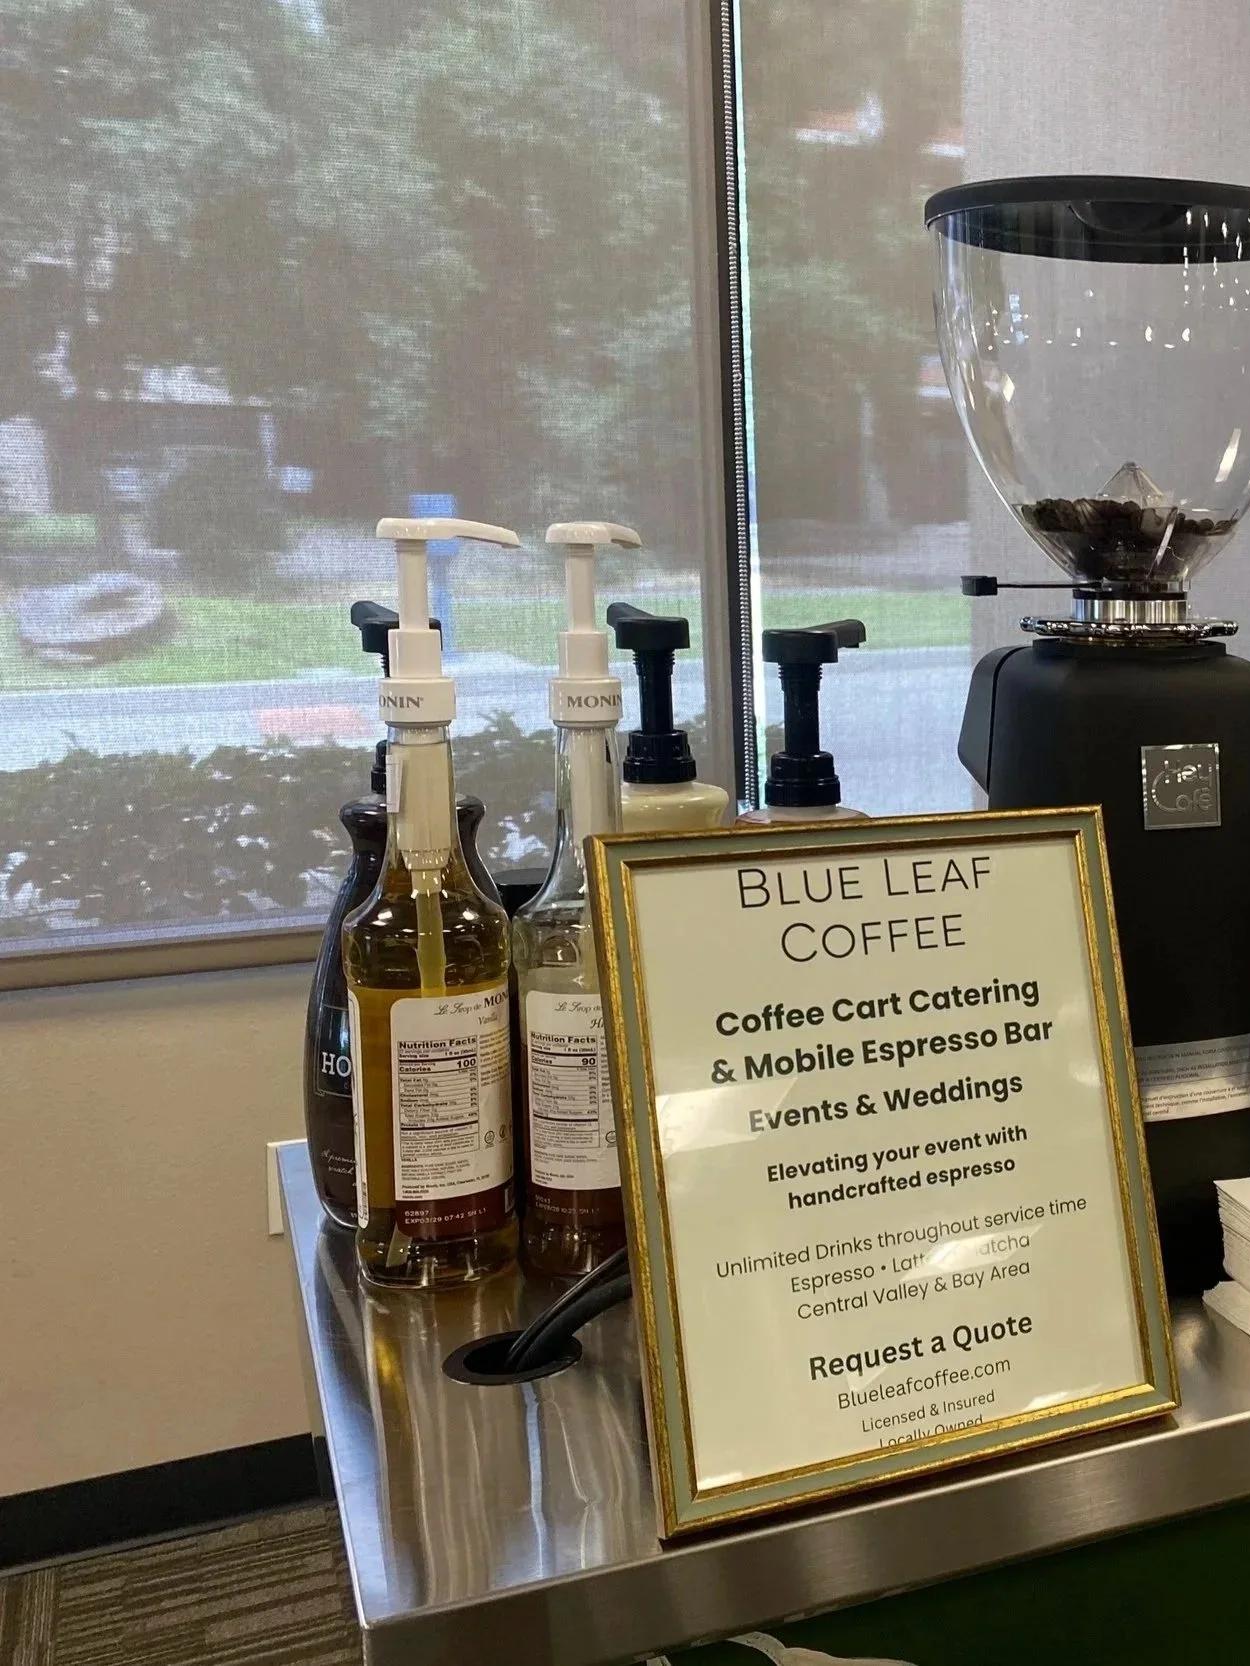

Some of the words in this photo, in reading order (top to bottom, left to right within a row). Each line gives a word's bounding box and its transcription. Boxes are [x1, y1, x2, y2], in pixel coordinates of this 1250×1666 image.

[379, 695, 421, 709] ONIN
[737, 866, 863, 909] BLUE
[884, 856, 990, 897] LEAF
[781, 914, 966, 962] COFFEE
[715, 1003, 825, 1036] Coffee
[832, 992, 902, 1022] Cart
[908, 977, 1040, 1008] Catering
[399, 1040, 447, 1049] Nutrition
[449, 1037, 477, 1047] Facts
[457, 1058, 476, 1069] 100
[531, 1032, 566, 1043] Nutrition
[567, 1036, 596, 1044] Facts
[581, 1057, 596, 1066] 90
[711, 1058, 737, 1084] &
[744, 1044, 854, 1080] Mobile
[862, 1026, 998, 1068] Espresso
[1004, 1018, 1053, 1044] Bar
[749, 1099, 848, 1133] Events
[856, 1093, 878, 1116] &
[883, 1074, 1023, 1112] Weddings
[767, 1152, 868, 1182] Elevating
[872, 1144, 920, 1170] your
[924, 1131, 982, 1156] event
[985, 1124, 1028, 1146] with
[788, 1170, 922, 1209] handcrafted
[926, 1156, 1016, 1186] espresso
[716, 1246, 811, 1279] Unlimited
[815, 1236, 873, 1260] Drinks
[877, 1215, 980, 1248] throughout
[984, 1205, 1045, 1228] service
[1049, 1197, 1088, 1216] time
[790, 1266, 875, 1294] Espresso
[797, 1291, 869, 1320] Central
[873, 1280, 929, 1305] Valley
[934, 1276, 947, 1292] &
[952, 1270, 985, 1290] Bay
[990, 1261, 1031, 1281] Area
[809, 1335, 924, 1381] Request
[930, 1335, 946, 1353] a
[952, 1314, 1033, 1351] Quote
[837, 1359, 1011, 1410] Blueleafcoffee.com
[862, 1405, 926, 1433] Licensed
[930, 1403, 940, 1417] &
[943, 1389, 996, 1413] Insured
